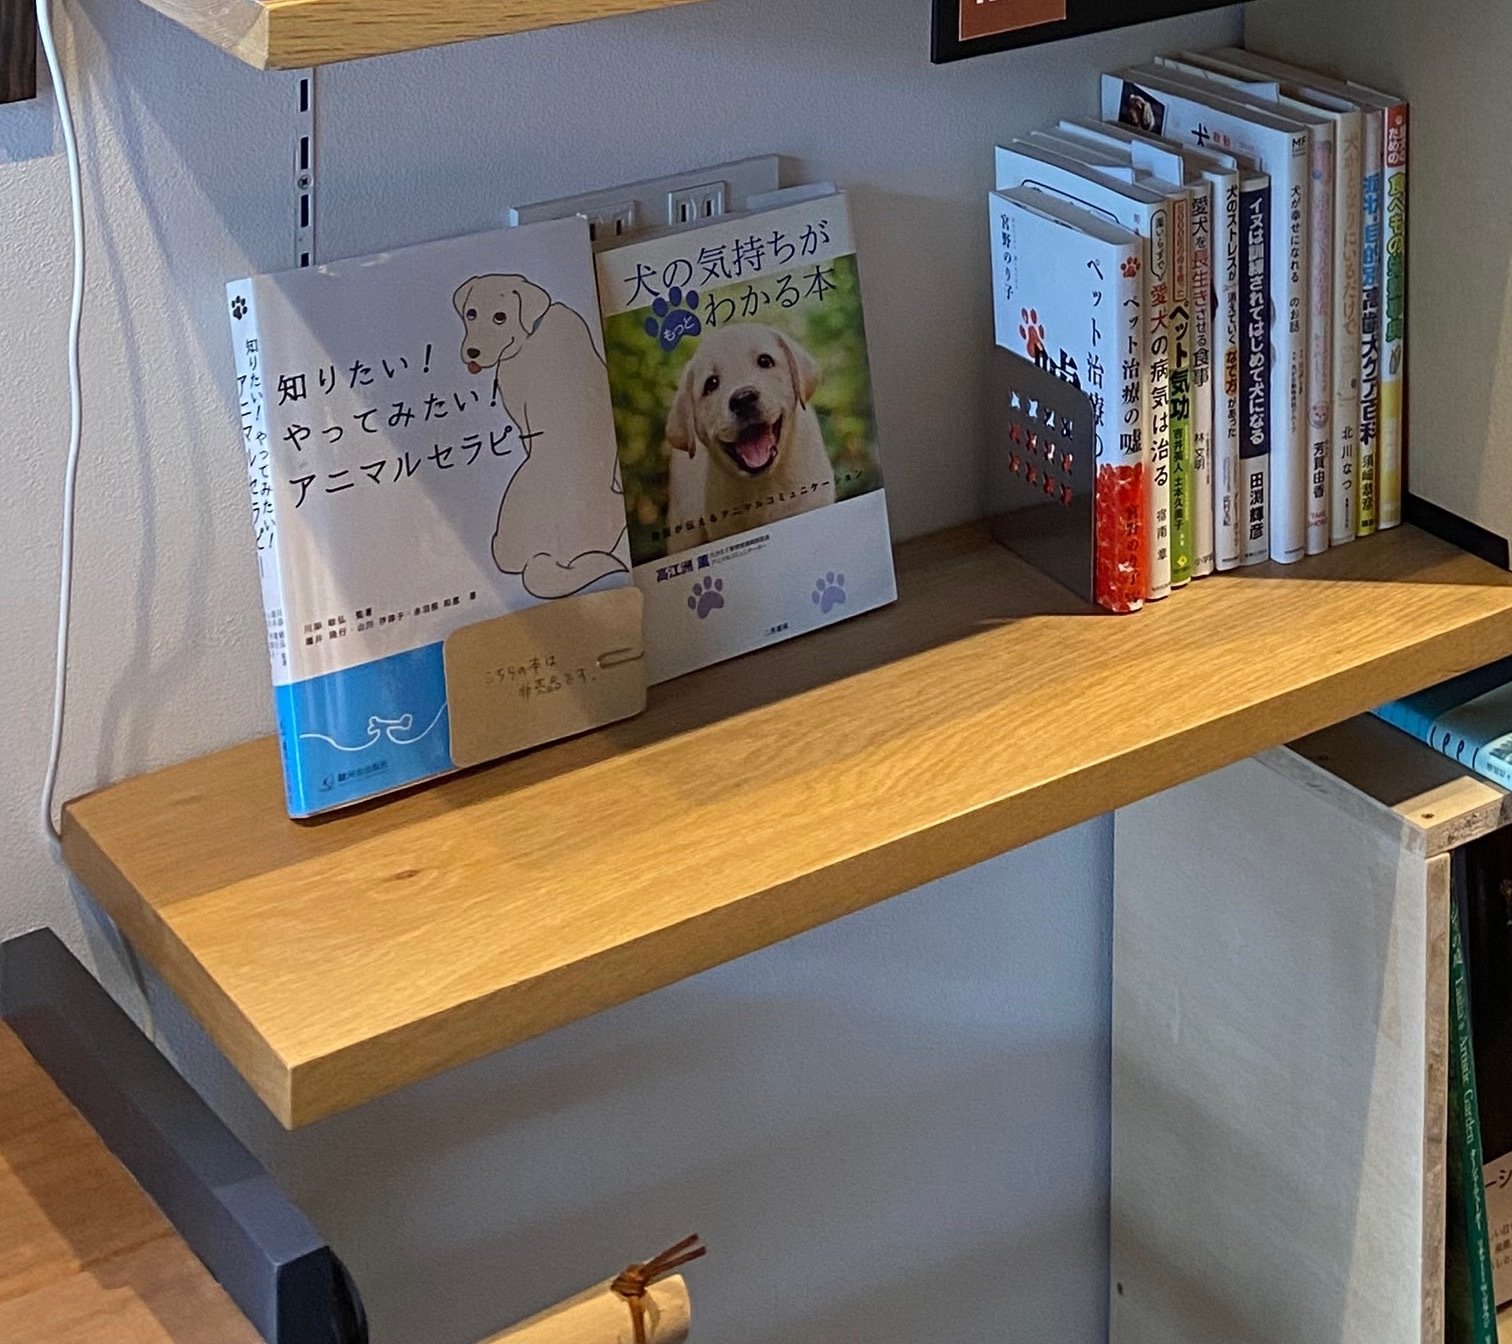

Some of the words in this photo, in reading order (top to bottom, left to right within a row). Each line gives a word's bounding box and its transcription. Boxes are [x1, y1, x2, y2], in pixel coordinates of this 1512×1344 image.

[623, 216, 831, 306] 犬の気持ちが
[704, 263, 837, 327] わかる本
[661, 314, 697, 342] もっと
[1169, 302, 1191, 423] ペット気功
[1248, 198, 1265, 446] イヌは訓練されてはじめて犬になる
[276, 343, 434, 406] 知りたい!
[283, 382, 499, 451] やってみたい!
[1119, 295, 1143, 455] ペット治療の嘘
[1150, 281, 1171, 488] 愛犬の病気は治る
[236, 375, 268, 578] アニマルセラピー
[289, 422, 545, 508] アニマルセラピー
[1341, 425, 1353, 491] 北川なつ
[484, 652, 557, 686] こちらの本は
